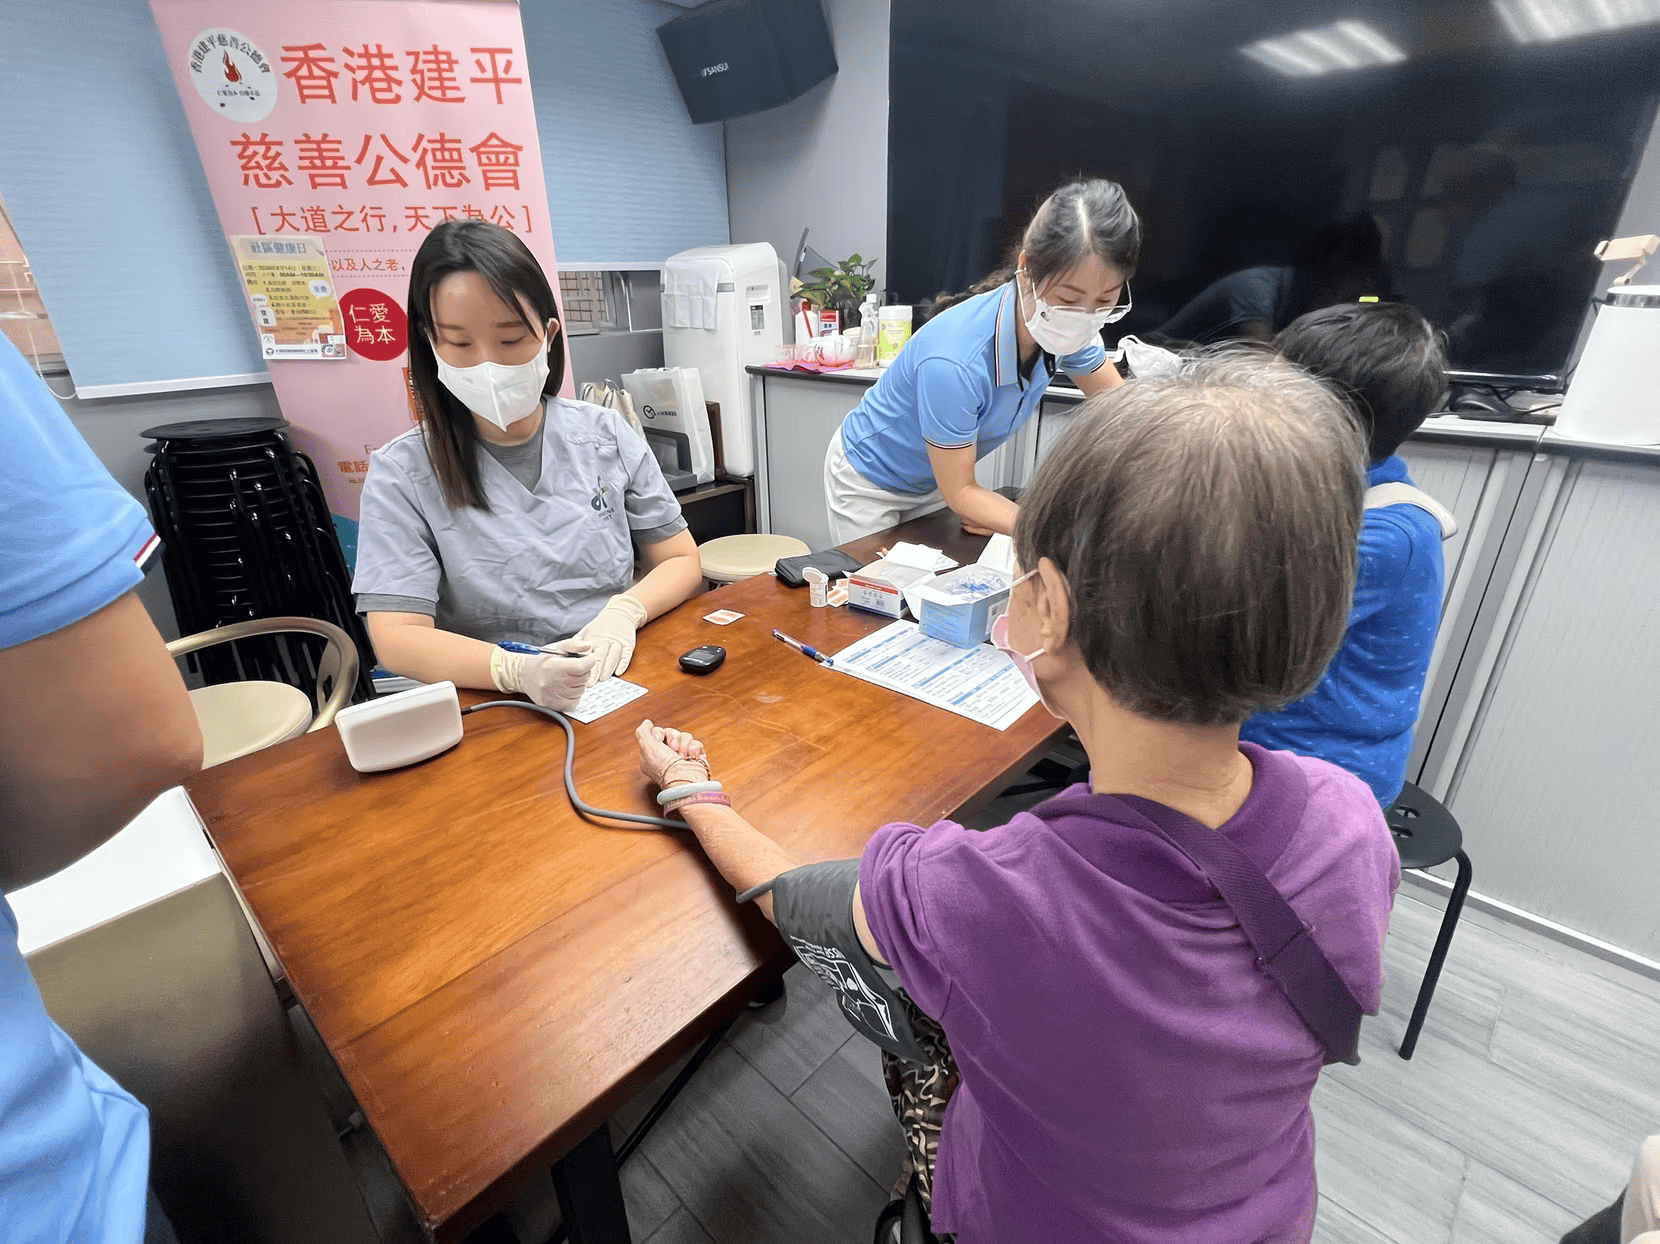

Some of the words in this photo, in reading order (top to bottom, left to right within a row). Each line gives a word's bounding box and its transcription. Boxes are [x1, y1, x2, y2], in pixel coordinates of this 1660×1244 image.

[279, 42, 523, 105] 香港建平
[706, 62, 730, 76] SANSUI
[229, 132, 524, 192] 慈善公德會
[348, 302, 392, 324] 仁愛
[354, 325, 397, 345] 為本
